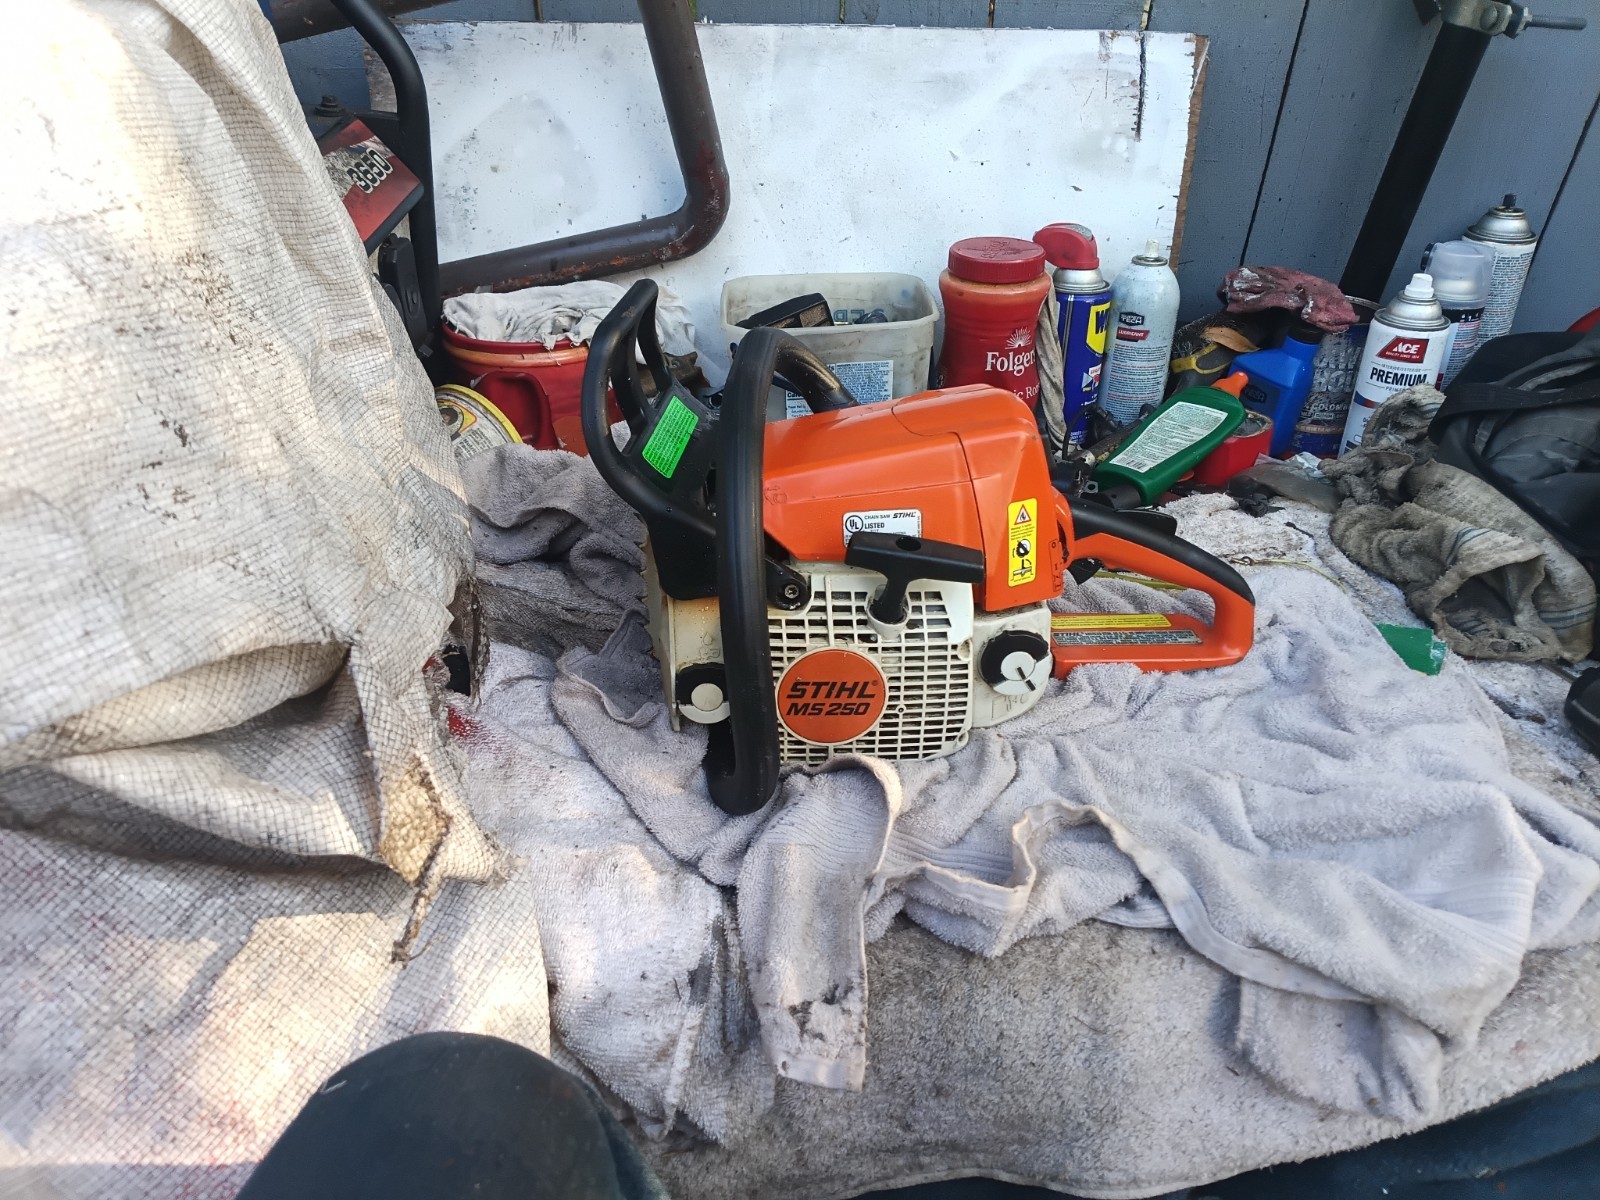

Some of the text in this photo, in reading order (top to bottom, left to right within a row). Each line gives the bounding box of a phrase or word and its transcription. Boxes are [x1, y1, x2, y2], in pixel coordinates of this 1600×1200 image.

[346, 148, 393, 193] 3650
[1392, 341, 1420, 354] ACE
[1369, 366, 1427, 387] PREMIUM
[892, 511, 916, 519] STIHL
[849, 519, 860, 529] UL
[786, 702, 871, 716] MS 250
